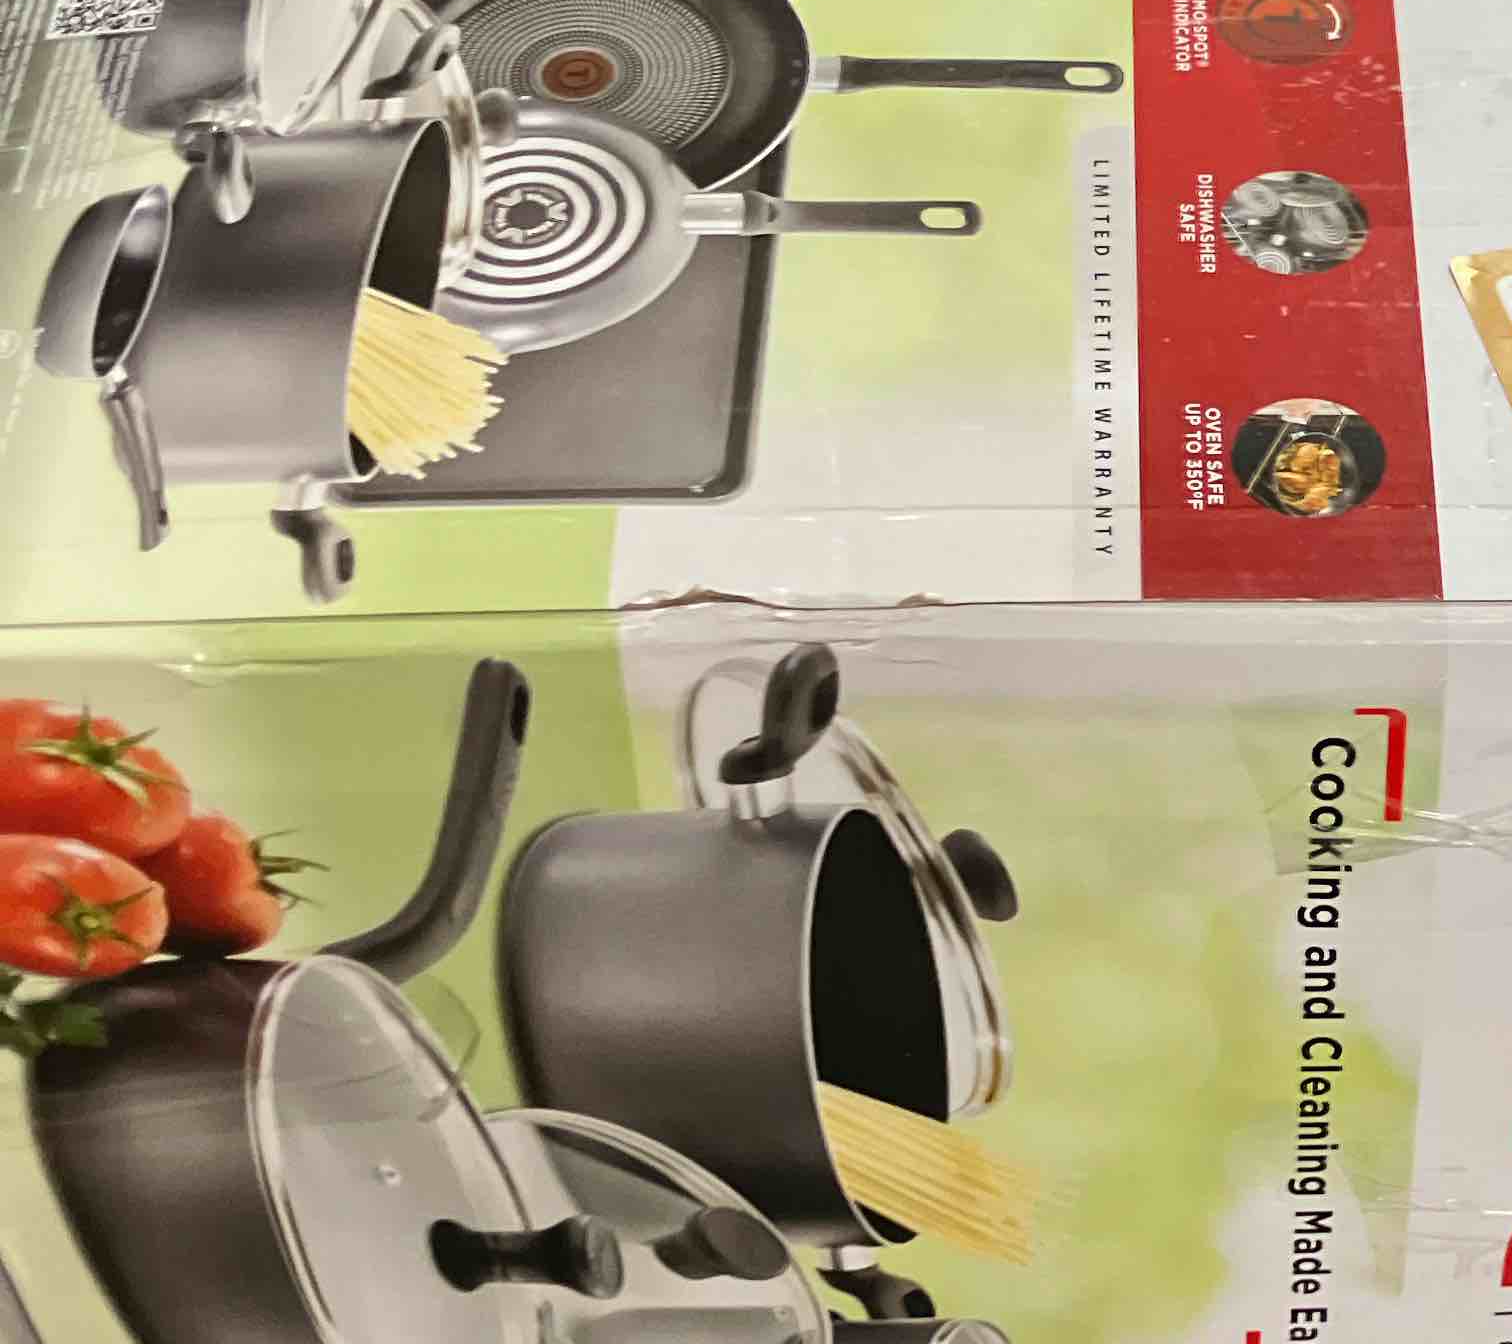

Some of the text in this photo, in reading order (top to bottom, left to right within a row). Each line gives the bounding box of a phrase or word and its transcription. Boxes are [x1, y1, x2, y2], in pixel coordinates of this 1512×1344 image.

[1173, 1, 1190, 73] INDICATOR
[1179, 203, 1195, 243] SAFE
[1197, 174, 1216, 274] DISHWASHER
[1092, 159, 1113, 555] LIMITED LIFETIME WARRANTY
[1184, 402, 1200, 429] UP
[1186, 432, 1202, 454] TO
[1205, 407, 1225, 506] OVEN SAFE
[1298, 737, 1355, 930] Cooking
[1302, 946, 1345, 1019] and
[1287, 1036, 1343, 1198] Cleaning
[1290, 1210, 1333, 1295] Made
